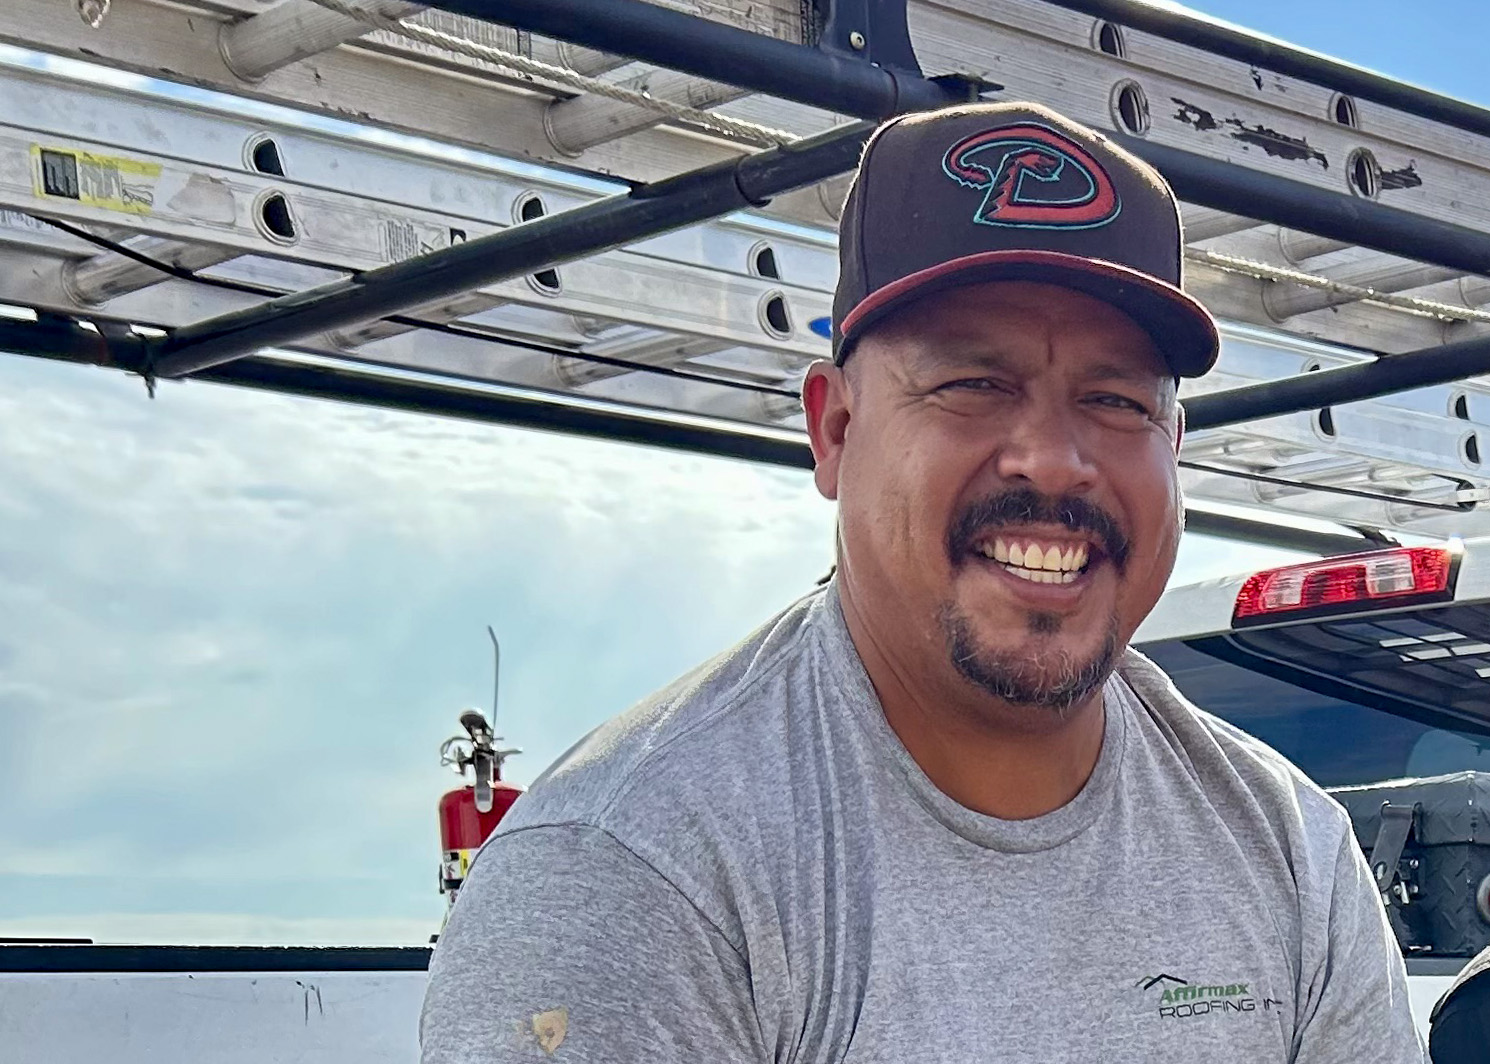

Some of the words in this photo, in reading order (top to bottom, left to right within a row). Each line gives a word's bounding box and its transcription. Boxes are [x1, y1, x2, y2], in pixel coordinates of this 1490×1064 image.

[1160, 982, 1250, 1004] Affirmax
[1159, 998, 1256, 1019] ROOFING
[1263, 998, 1283, 1015] IN
